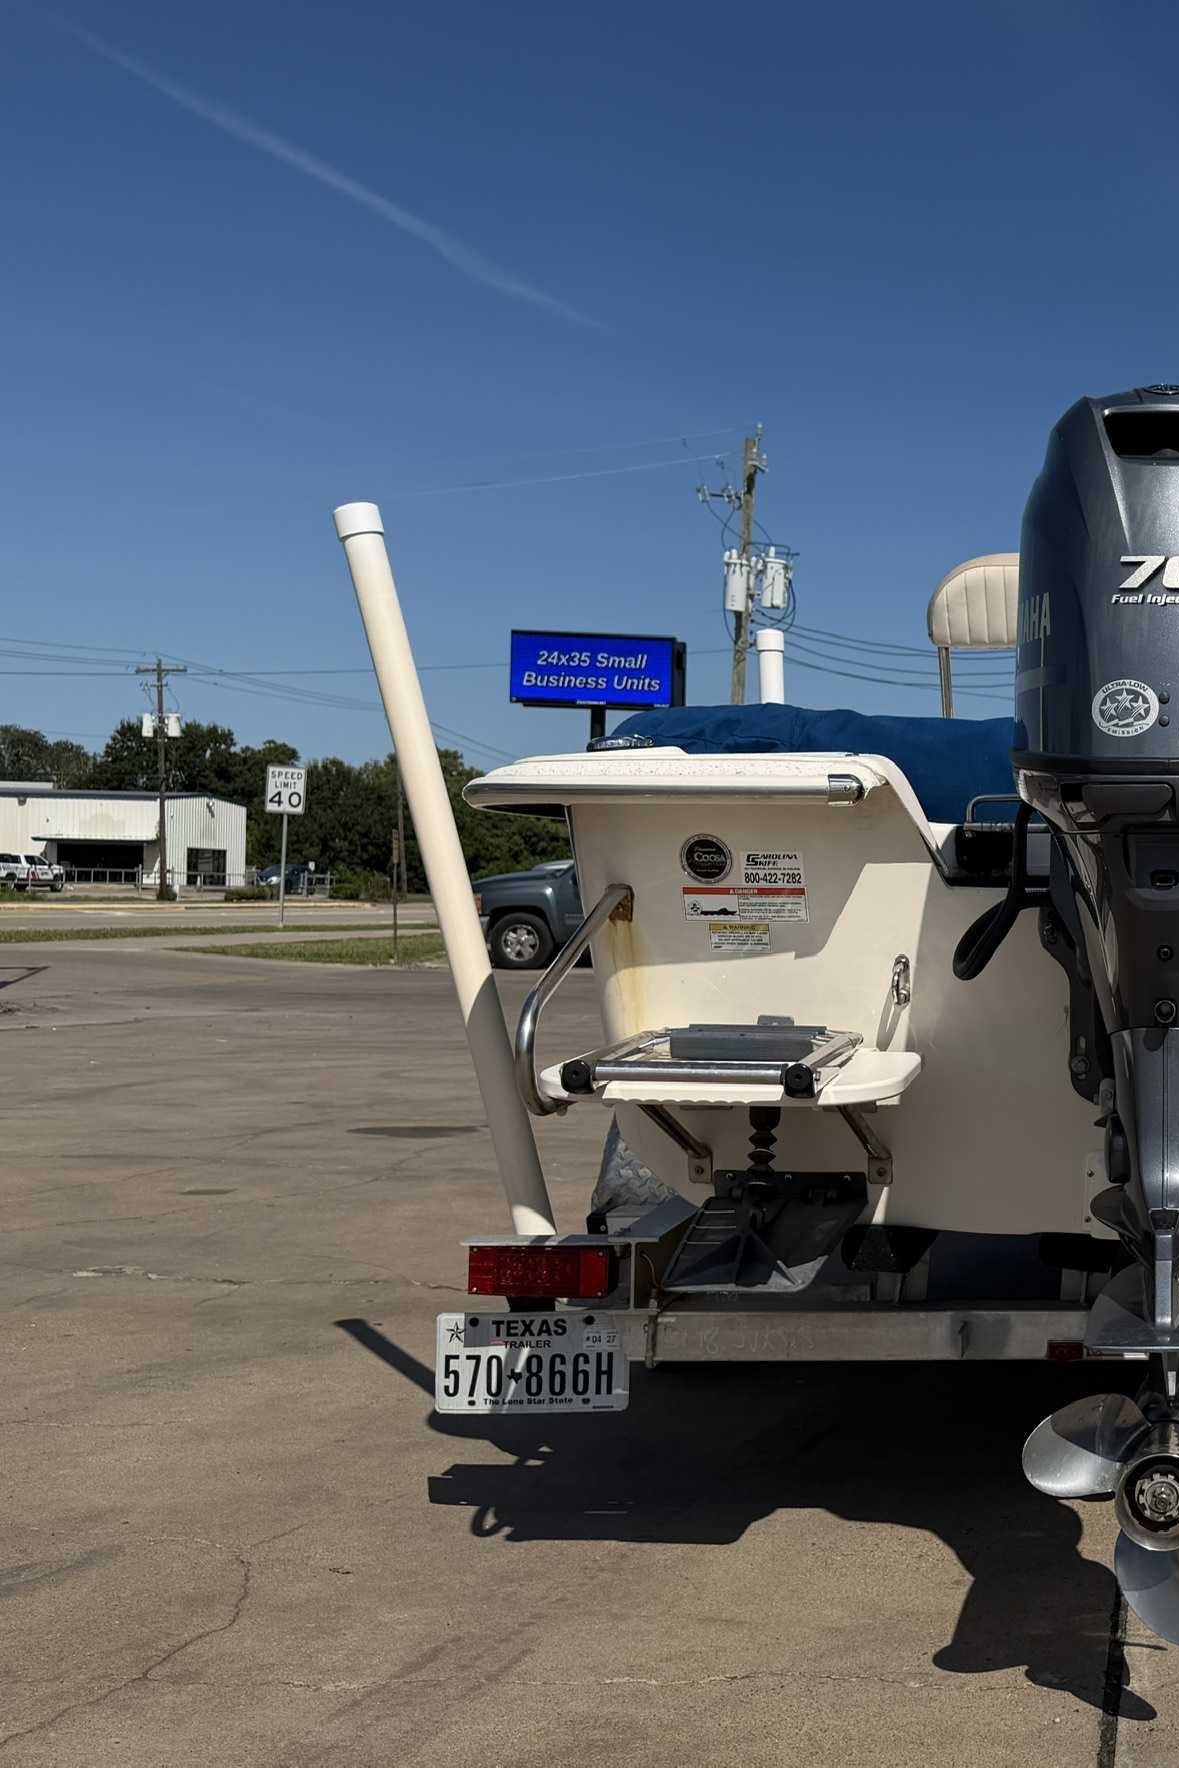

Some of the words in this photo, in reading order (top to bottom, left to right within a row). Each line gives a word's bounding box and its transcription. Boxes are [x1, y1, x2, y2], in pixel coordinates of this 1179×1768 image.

[1111, 593, 1144, 605] Fuel
[536, 650, 591, 667] 24x35
[595, 652, 648, 669] Small
[522, 671, 608, 689] Business
[613, 674, 661, 691] Units
[1102, 681, 1127, 693] ULTRA
[1129, 681, 1149, 692] LOW
[271, 770, 303, 780] SPEED
[275, 780, 297, 790] LIMIT
[268, 790, 302, 808] 40
[746, 853, 798, 862] CAROLINA
[744, 872, 802, 884] 800-422-7282
[491, 1318, 568, 1337] TEXAS
[503, 1339, 551, 1349] TRAILER
[443, 1354, 504, 1397] 570
[525, 1351, 615, 1397] 866H
[484, 1397, 499, 1406] The
[502, 1398, 523, 1406] Lone
[527, 1397, 545, 1405] Star
[549, 1397, 574, 1405] State
